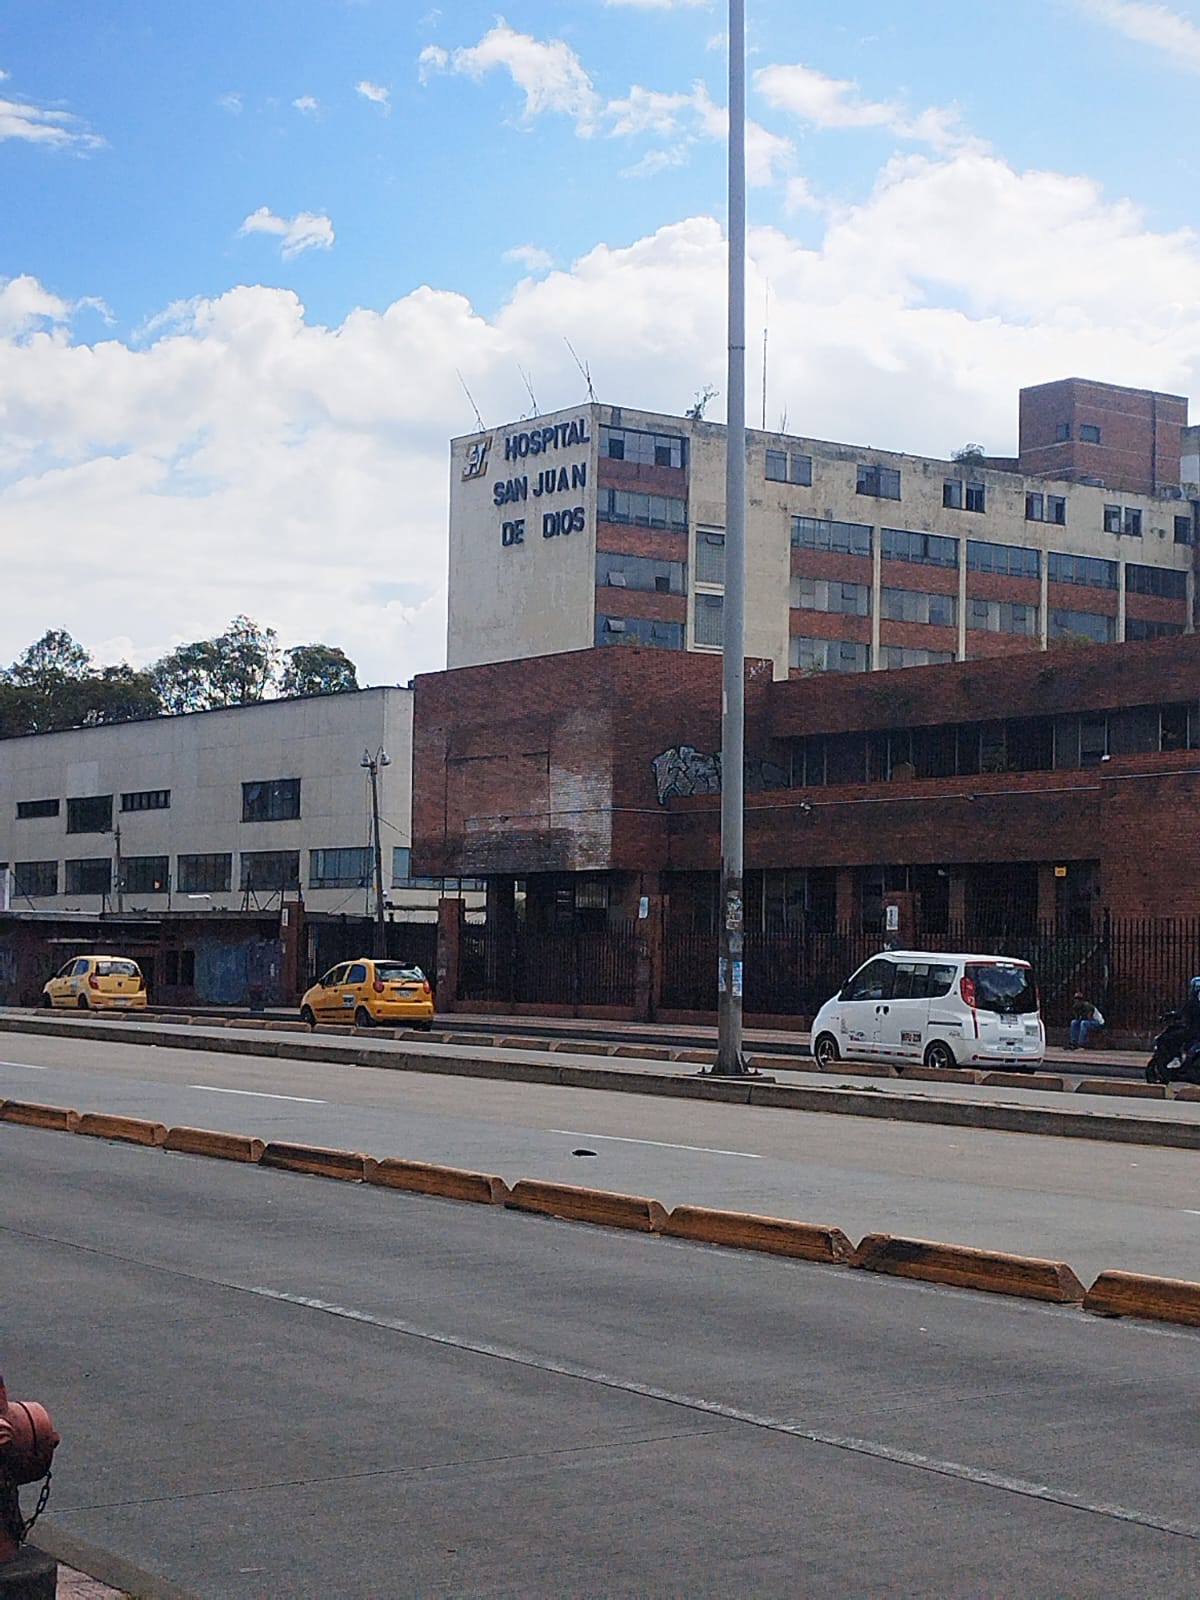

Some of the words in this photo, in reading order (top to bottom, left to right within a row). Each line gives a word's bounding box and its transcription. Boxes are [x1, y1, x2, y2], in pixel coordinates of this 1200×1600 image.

[504, 418, 591, 462] HOSPITAL
[493, 475, 528, 507] SAN
[532, 462, 587, 498] JUAN
[501, 518, 525, 547] DE
[542, 506, 586, 539] DIOS
